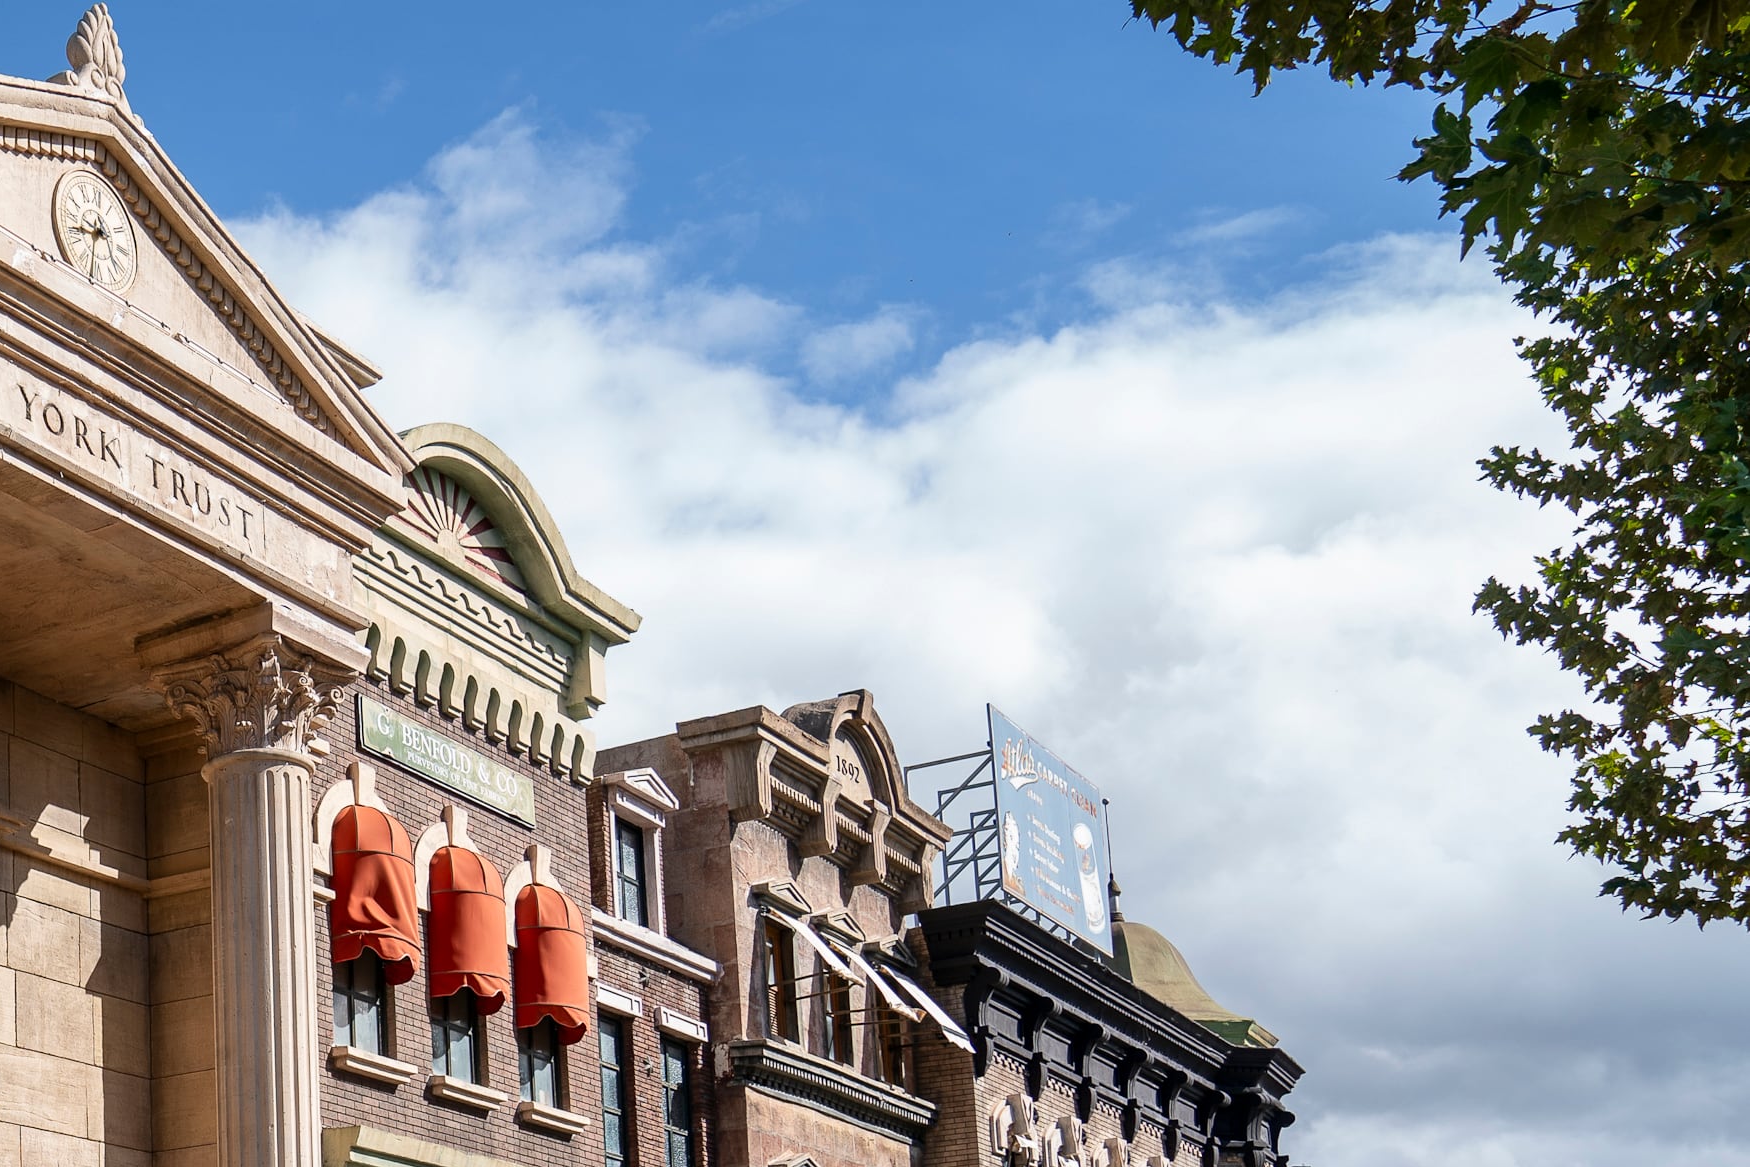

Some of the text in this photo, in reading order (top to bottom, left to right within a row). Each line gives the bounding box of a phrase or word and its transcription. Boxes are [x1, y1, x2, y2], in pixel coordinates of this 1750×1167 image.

[16, 383, 122, 470] YORK
[145, 453, 254, 540] TRUST
[401, 723, 472, 774] BENFOLD
[478, 762, 491, 786] &
[406, 750, 448, 778] PURVEYORS
[450, 772, 461, 785] OF
[836, 755, 860, 784] 1892
[1001, 737, 1037, 780] Atlas
